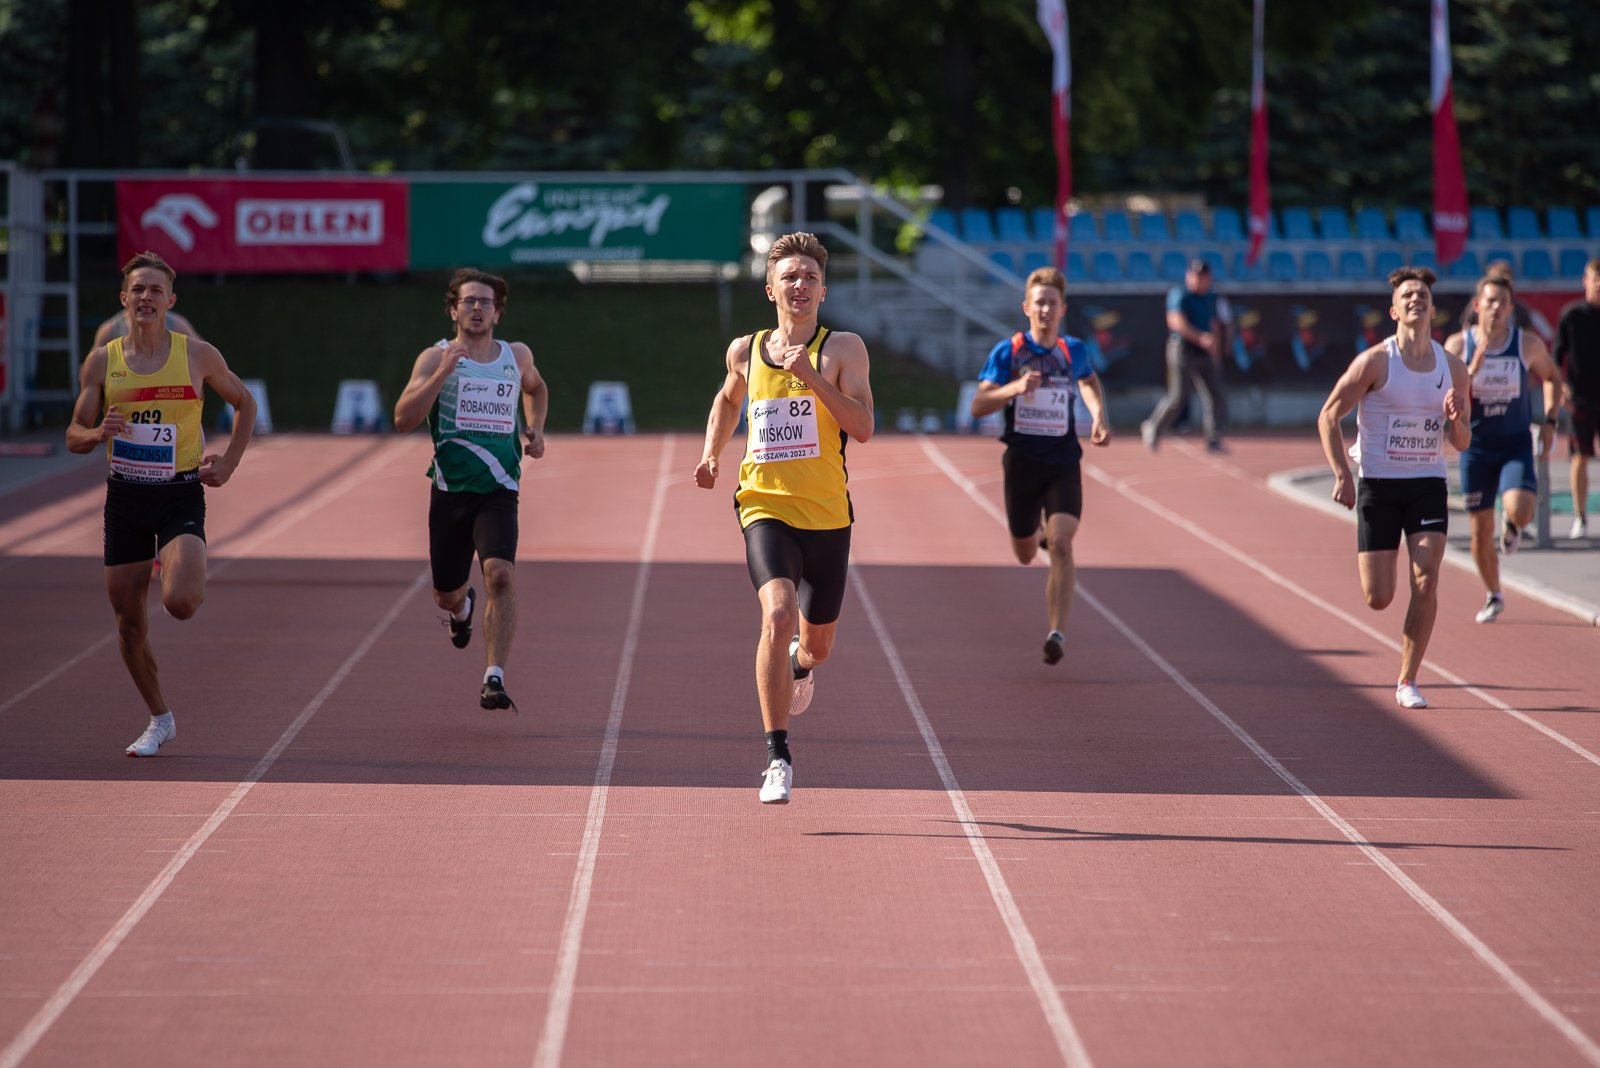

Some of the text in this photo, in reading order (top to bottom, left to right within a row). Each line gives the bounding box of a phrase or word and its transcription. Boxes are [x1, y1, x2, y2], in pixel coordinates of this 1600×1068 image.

[246, 210, 370, 235] ORLEN
[496, 383, 513, 398] 87
[1050, 391, 1066, 405] 74
[460, 400, 512, 416] ROBAKOWSKI
[789, 400, 812, 417] 82
[460, 422, 491, 430] WARSZAWA
[1424, 418, 1440, 431] 86
[152, 428, 172, 442] 73
[759, 422, 803, 443] MIŚKÓW
[1389, 435, 1438, 449] PRZYBYLSKI
[115, 443, 172, 463] BRZEZIŃSKI
[755, 451, 789, 460] WARSZAWA
[114, 465, 147, 476] WARSZAWA
[148, 469, 163, 477] 2022
